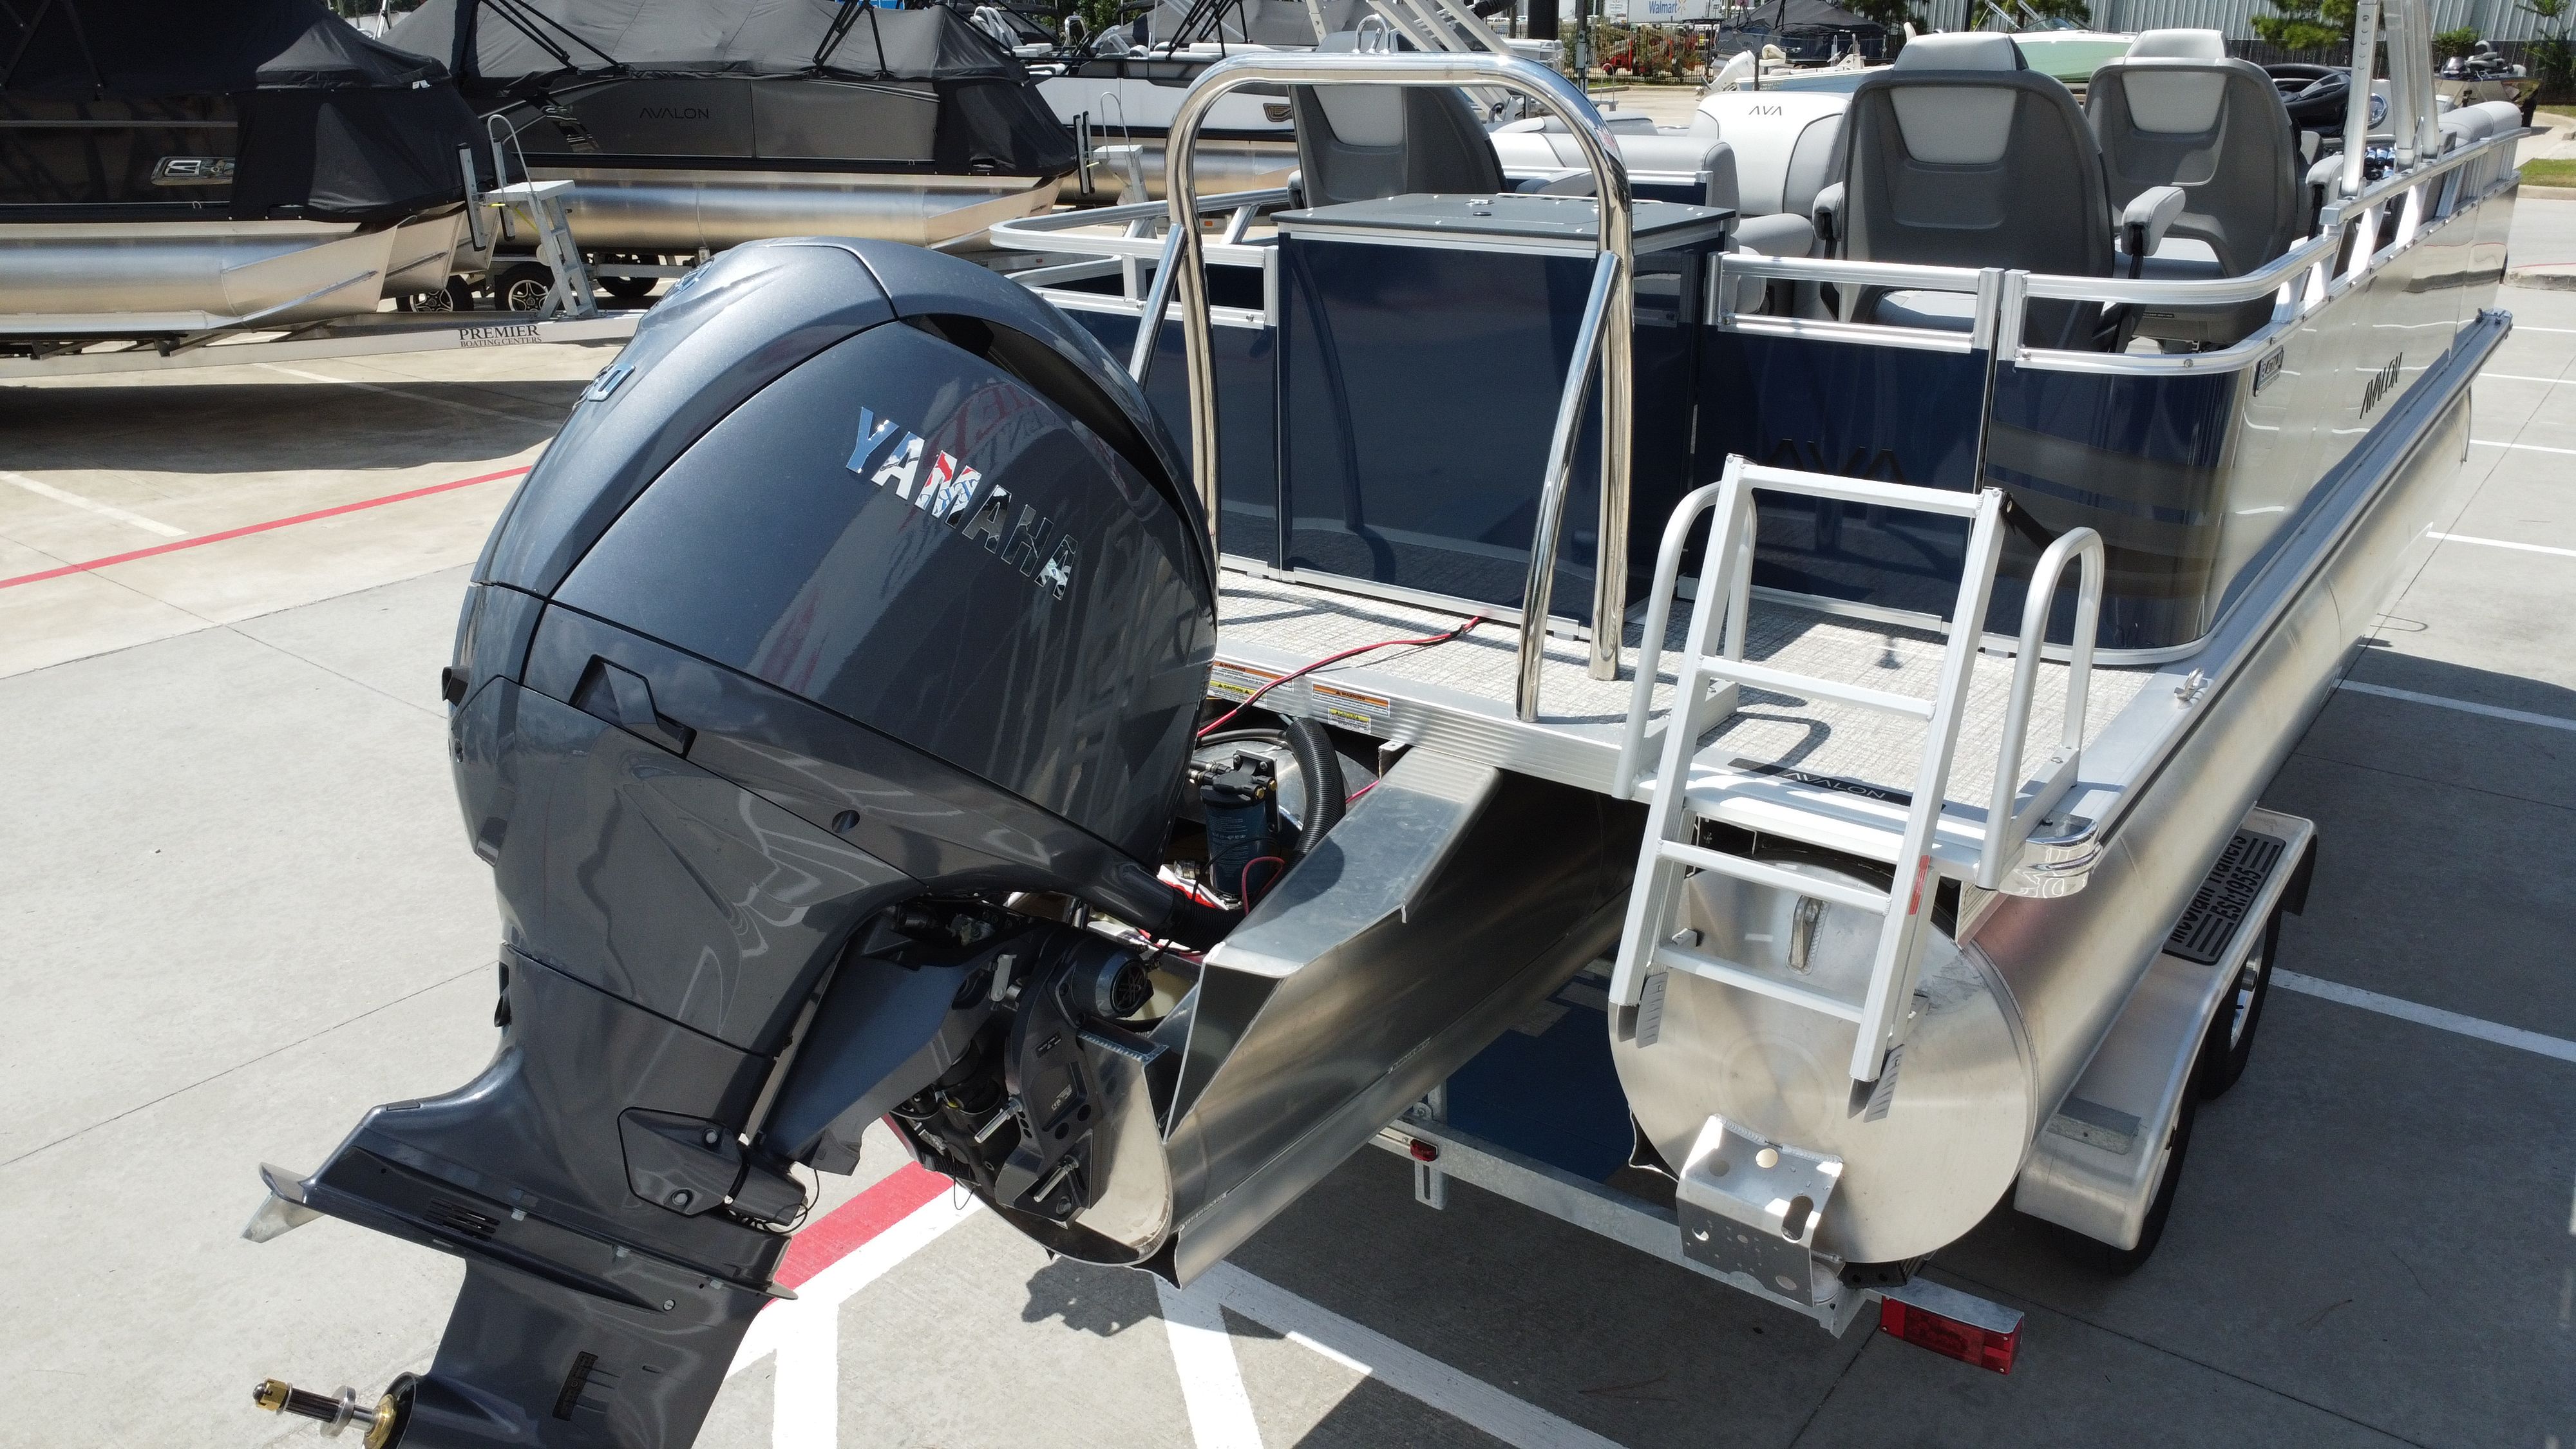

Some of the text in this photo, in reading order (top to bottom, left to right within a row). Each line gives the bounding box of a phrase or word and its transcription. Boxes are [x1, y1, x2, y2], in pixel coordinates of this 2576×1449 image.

[1649, 1, 1678, 14] Walmart
[639, 107, 709, 119] AVALON
[1748, 105, 1782, 116] AVA
[458, 325, 541, 340] PREMIER
[460, 336, 542, 347] BOATING CENTERS
[2358, 352, 2403, 419] AVALON
[846, 406, 1079, 601] YAMAHA
[1783, 772, 1886, 799] AVALON
